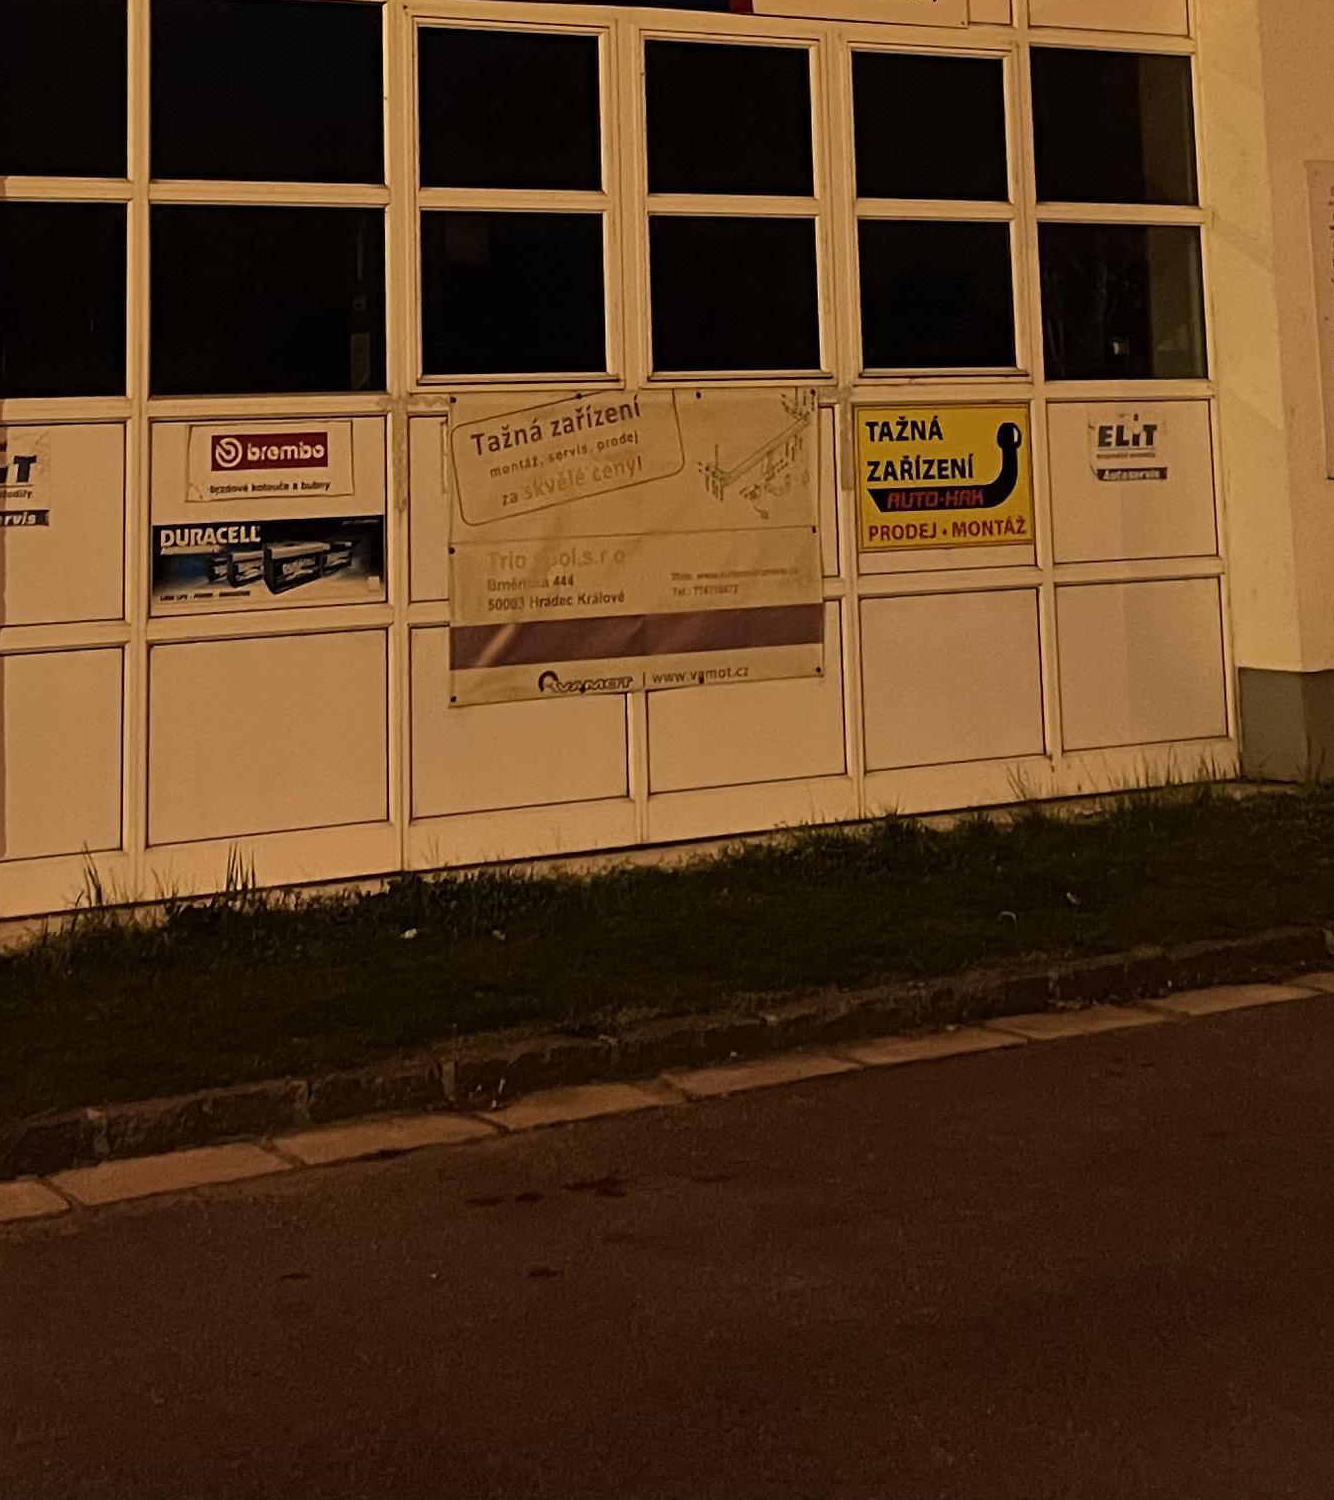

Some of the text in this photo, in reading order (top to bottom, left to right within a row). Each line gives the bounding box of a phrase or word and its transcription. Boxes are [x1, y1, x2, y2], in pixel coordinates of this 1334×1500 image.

[471, 393, 640, 456] Tažná zařízení
[865, 415, 943, 442] TAŽNÁ
[247, 441, 325, 461] brembo
[867, 453, 974, 482] ZAŘÍZENÍ
[502, 491, 519, 506] za
[160, 525, 261, 548] DURACELL
[868, 516, 1027, 541] PRODEJ MONTÁŽ
[553, 573, 574, 587] 444
[530, 593, 573, 608] Hradec
[578, 589, 625, 605] Králové
